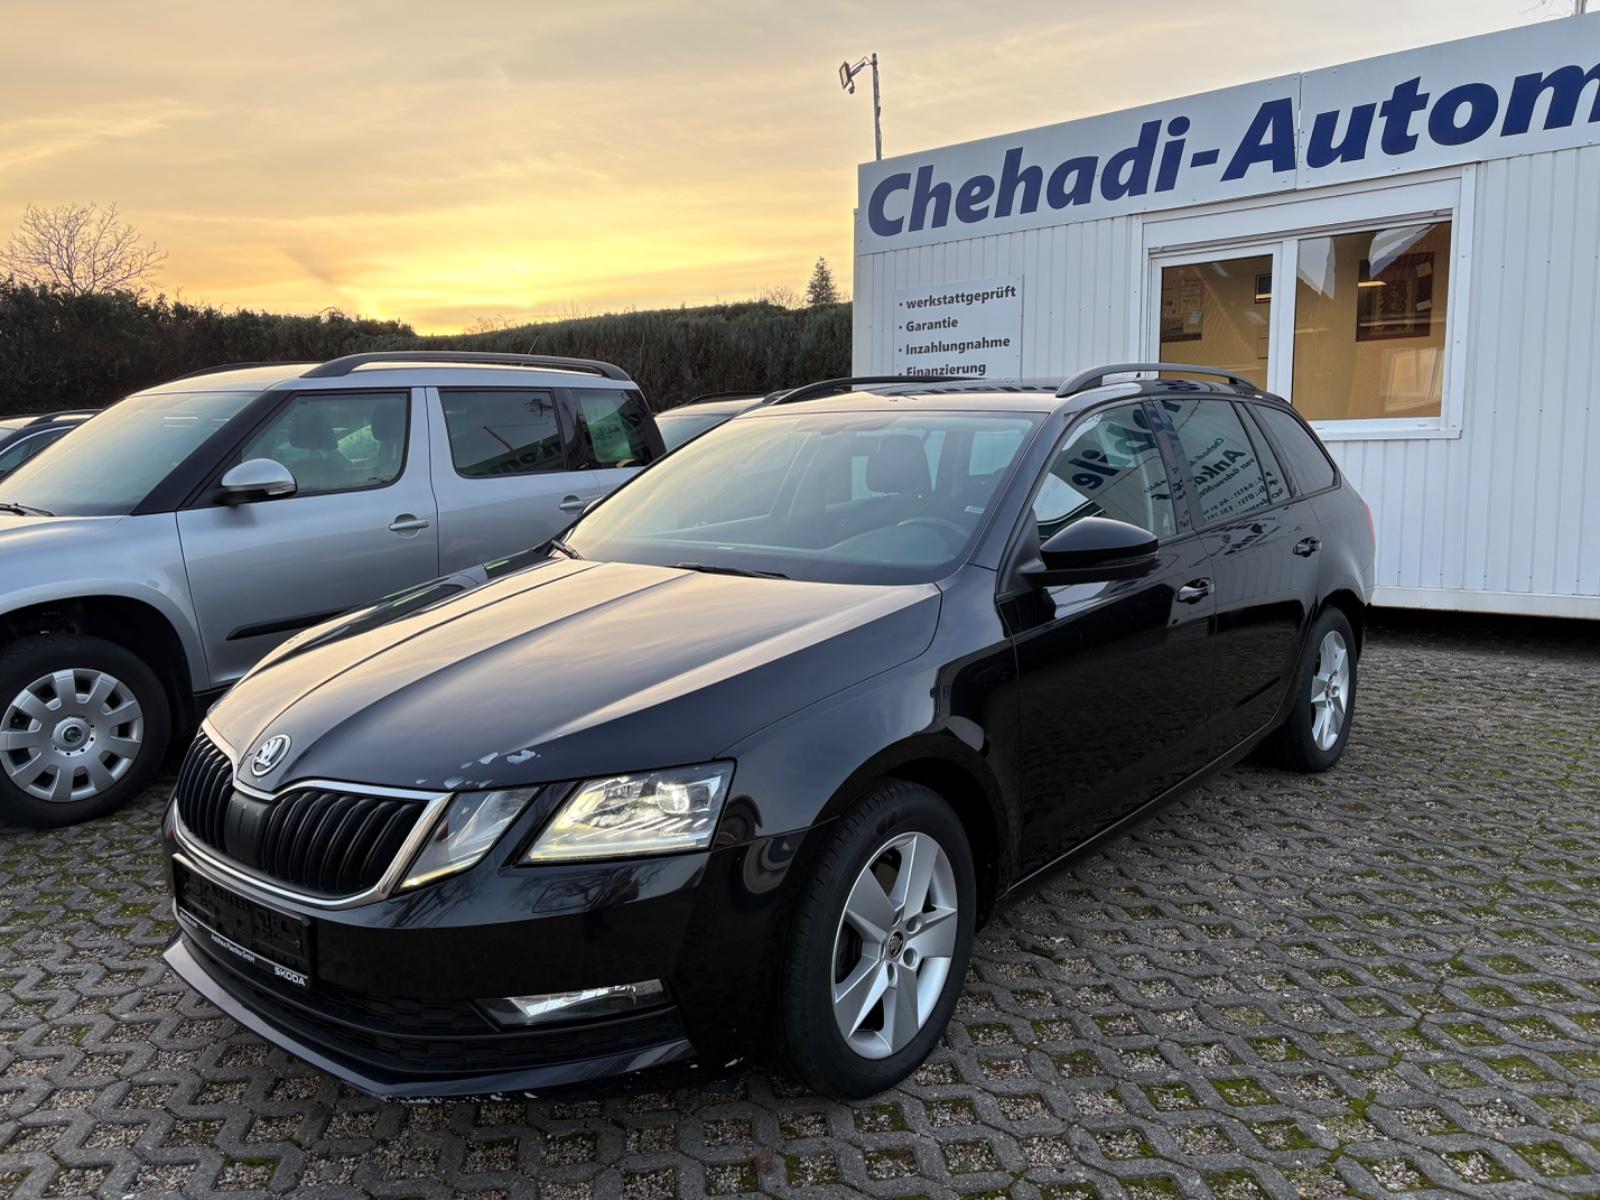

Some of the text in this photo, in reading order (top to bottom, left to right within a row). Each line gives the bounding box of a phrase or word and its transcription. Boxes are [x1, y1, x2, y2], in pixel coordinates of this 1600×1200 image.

[868, 64, 1600, 237] Chehadi-Autom
[906, 285, 1017, 309] werkstattgeprüft
[906, 316, 959, 332] Garantie
[906, 337, 1011, 355] Inzahlungnahme
[906, 363, 987, 376] Finanzierung
